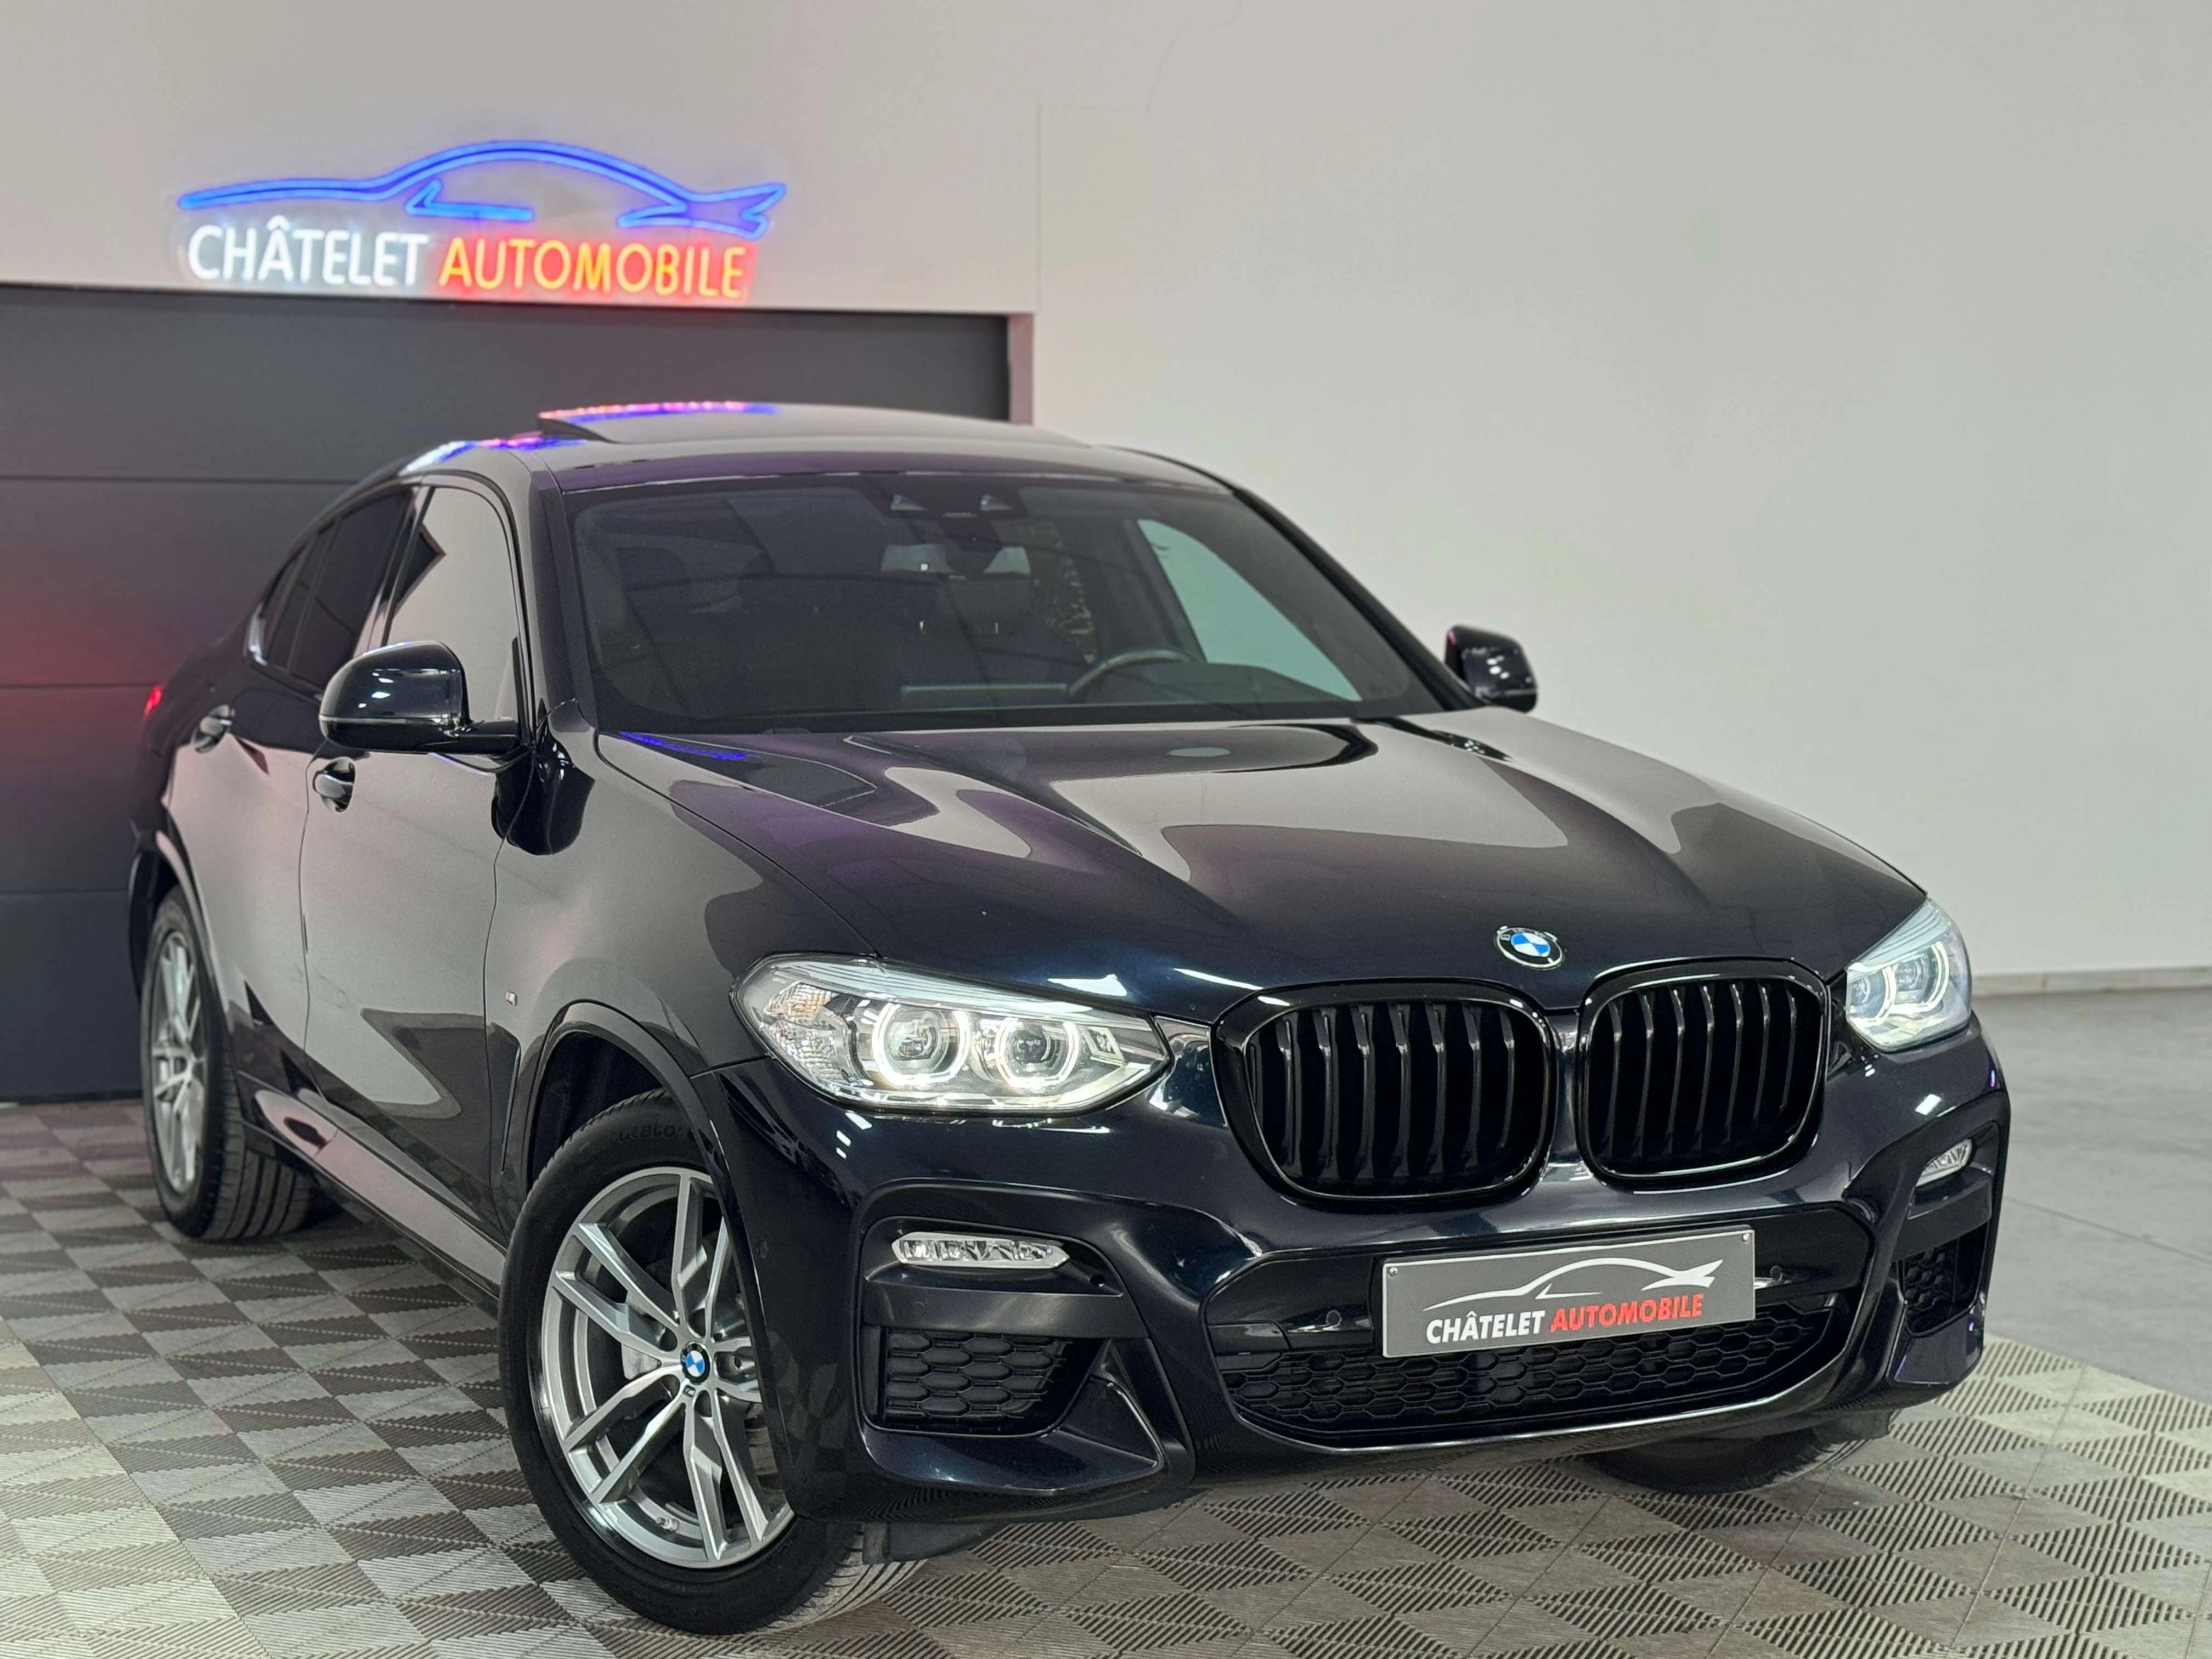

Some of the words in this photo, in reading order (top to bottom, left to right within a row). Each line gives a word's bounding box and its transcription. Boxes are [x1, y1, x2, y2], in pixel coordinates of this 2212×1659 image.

[188, 215, 430, 286] CHÂTELET
[438, 236, 746, 298] AUTOMOBILE
[1426, 1311, 1545, 1344] CHÂTELET
[1550, 1294, 1703, 1333] AUTOMOBILE
